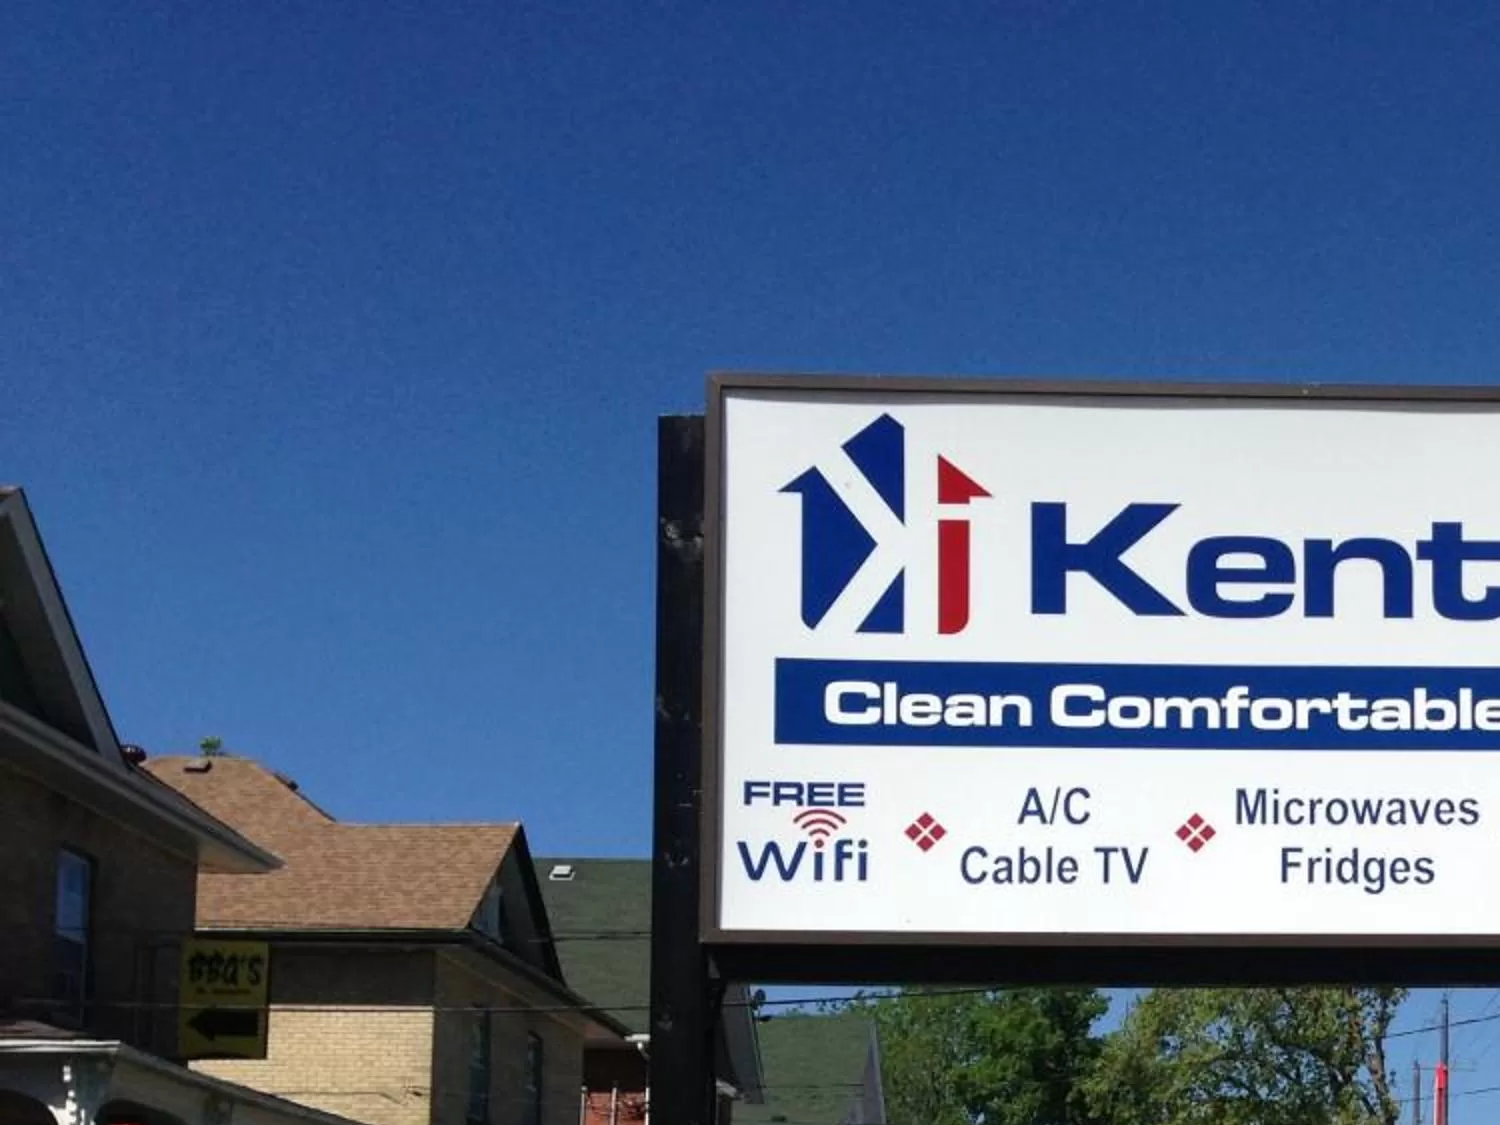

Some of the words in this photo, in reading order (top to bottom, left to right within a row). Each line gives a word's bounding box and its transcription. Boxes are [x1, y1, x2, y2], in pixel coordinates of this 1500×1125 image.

[824, 681, 1032, 728] Clean
[743, 781, 865, 806] FREE
[1018, 787, 1091, 826] A/C
[1236, 788, 1480, 827] Microwaves
[738, 838, 869, 882] Wifi
[960, 846, 1080, 886] Cable
[1094, 847, 1149, 885] TV
[1281, 847, 1436, 896] Fridges
